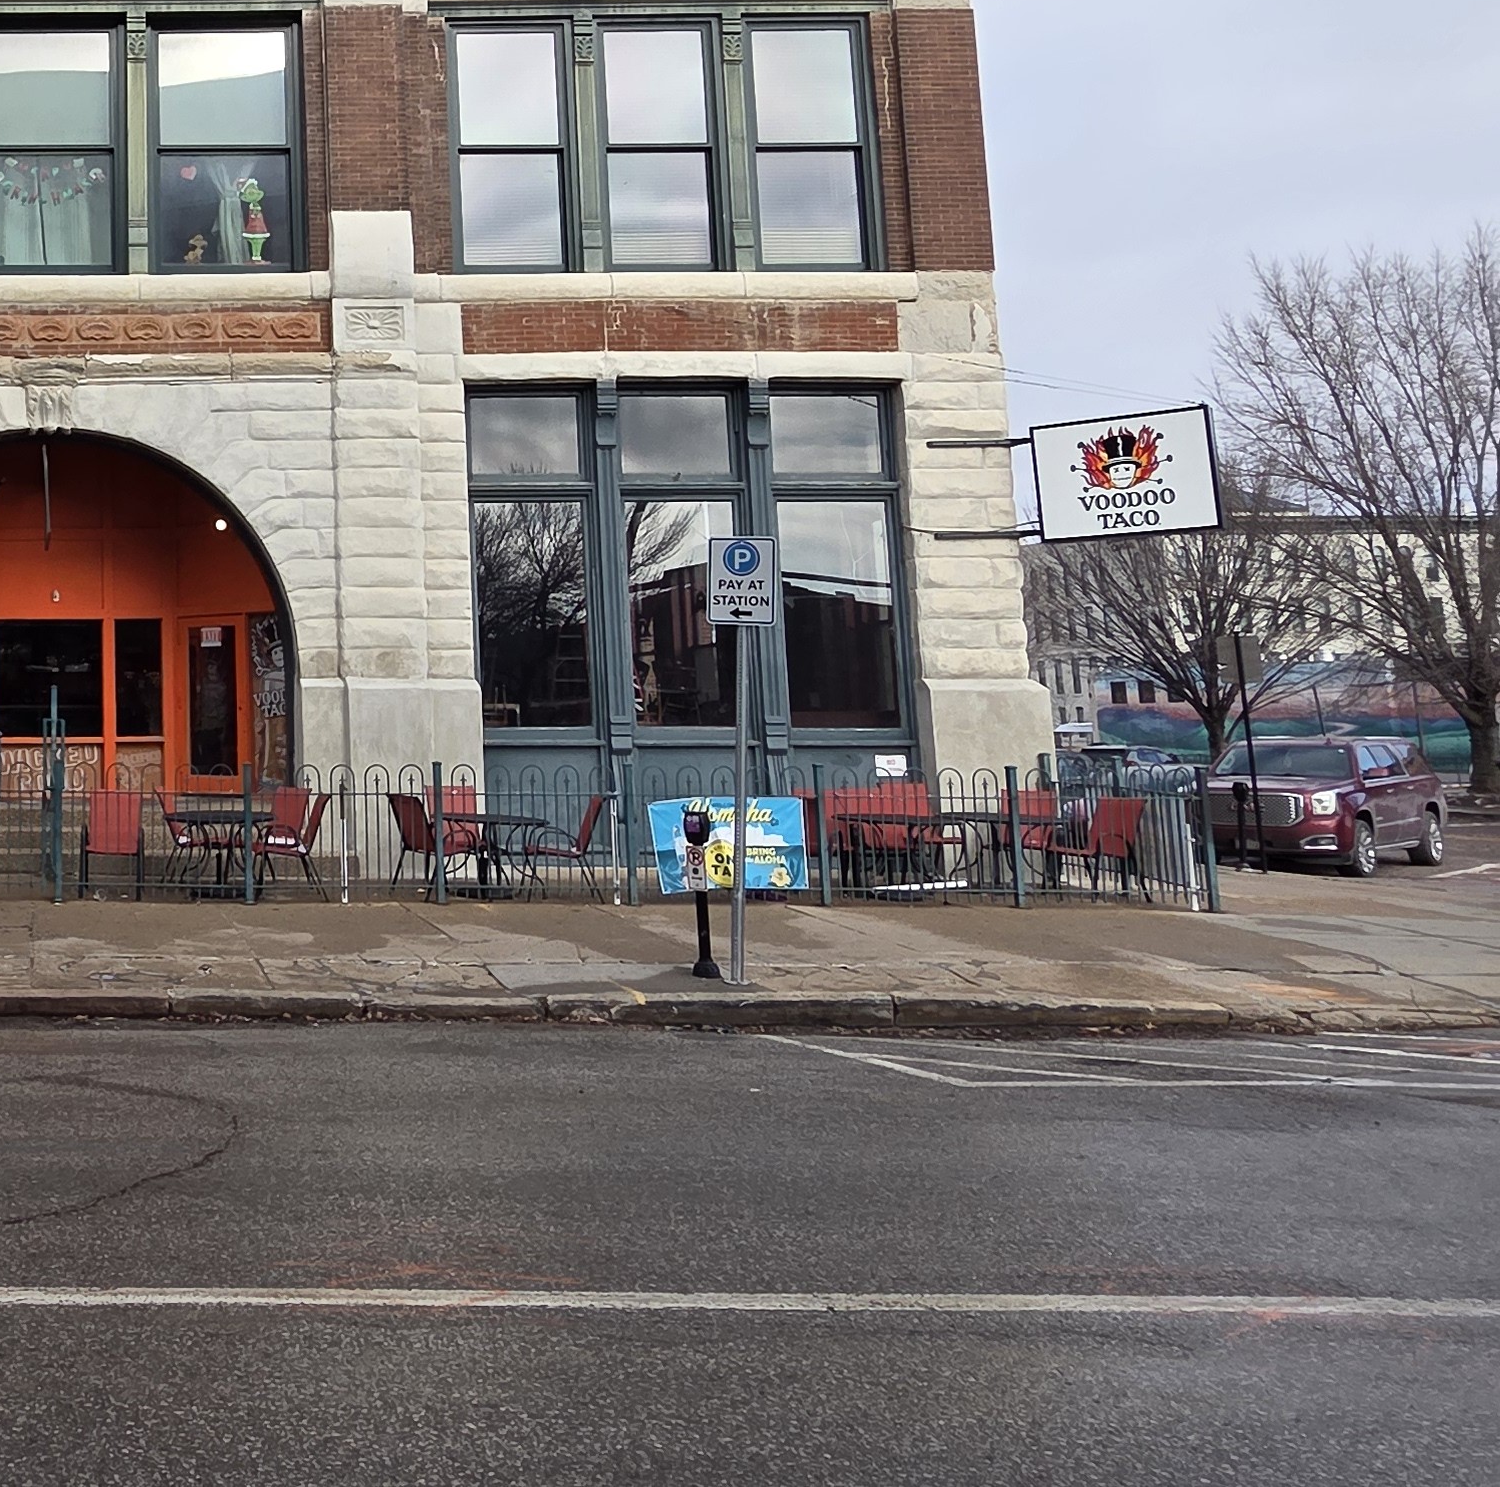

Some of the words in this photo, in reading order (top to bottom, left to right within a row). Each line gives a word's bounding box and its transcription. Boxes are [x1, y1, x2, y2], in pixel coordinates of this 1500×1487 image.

[1077, 488, 1176, 512] VOODOO
[1097, 510, 1161, 530] TACO
[718, 579, 744, 590] PAY
[747, 580, 765, 590] AT
[712, 595, 770, 607] STATION
[711, 865, 732, 877] TA
